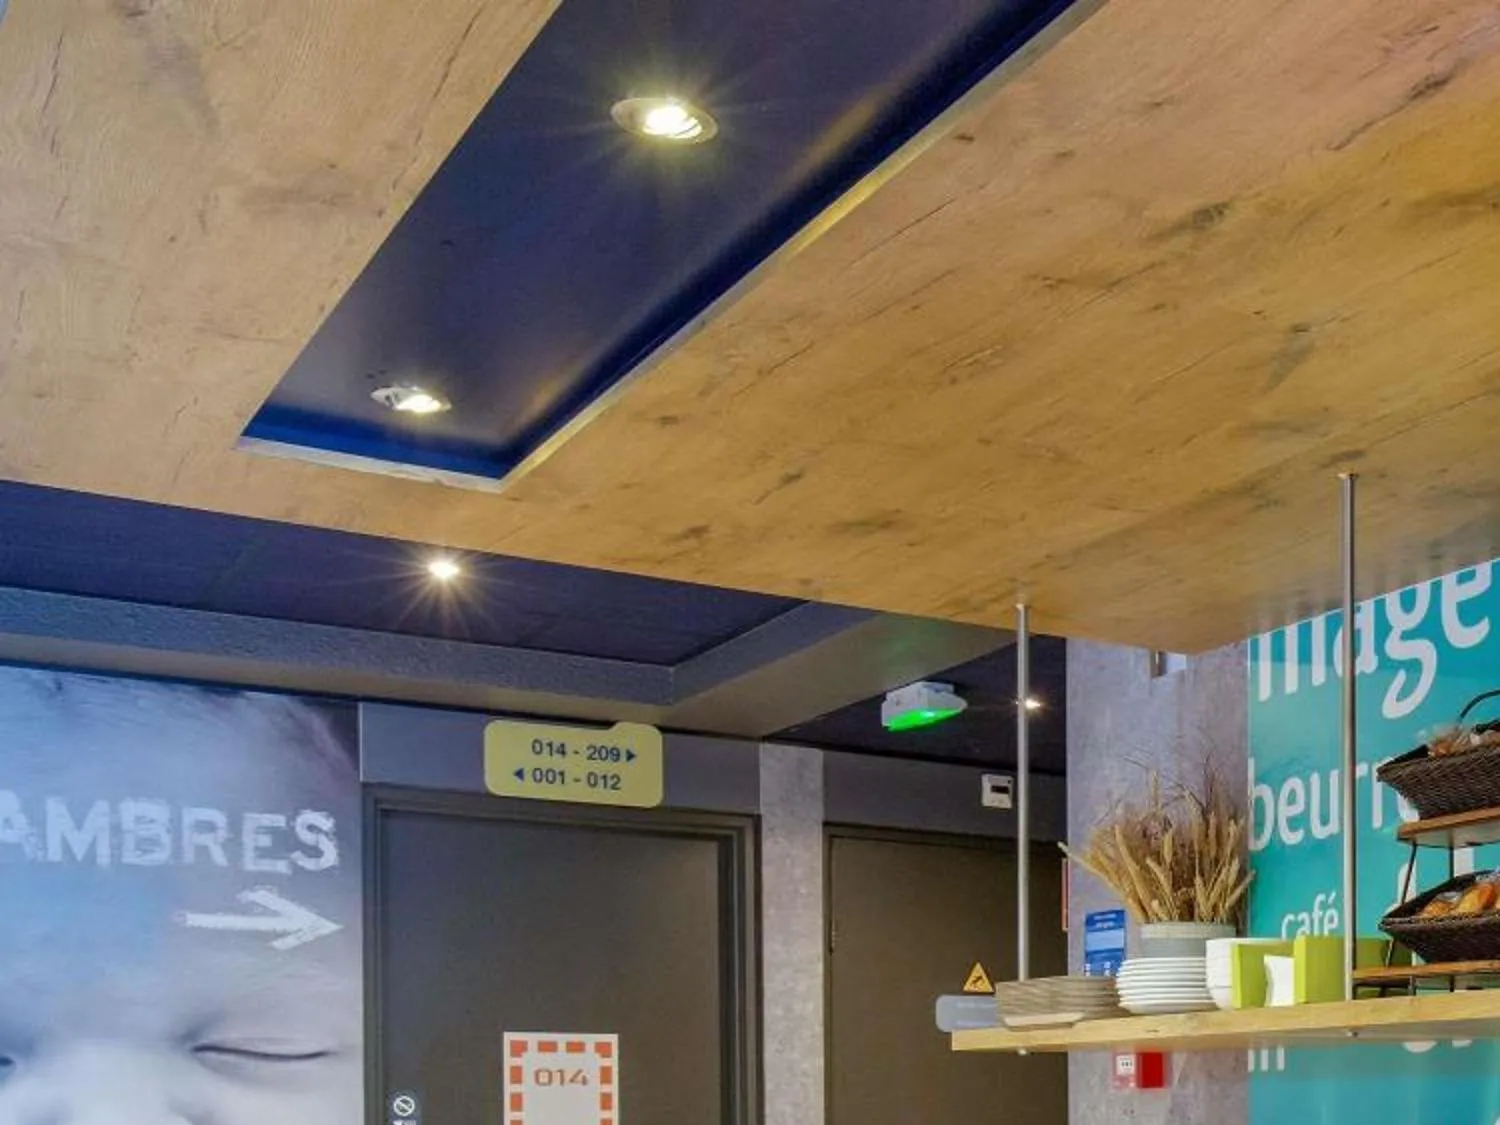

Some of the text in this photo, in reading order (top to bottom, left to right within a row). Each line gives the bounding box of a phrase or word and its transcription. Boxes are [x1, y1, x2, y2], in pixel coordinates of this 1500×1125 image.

[531, 738, 567, 758] 014
[586, 744, 621, 763] 209
[531, 767, 566, 785] 001
[586, 771, 622, 791] 012
[533, 1068, 589, 1087] 014
